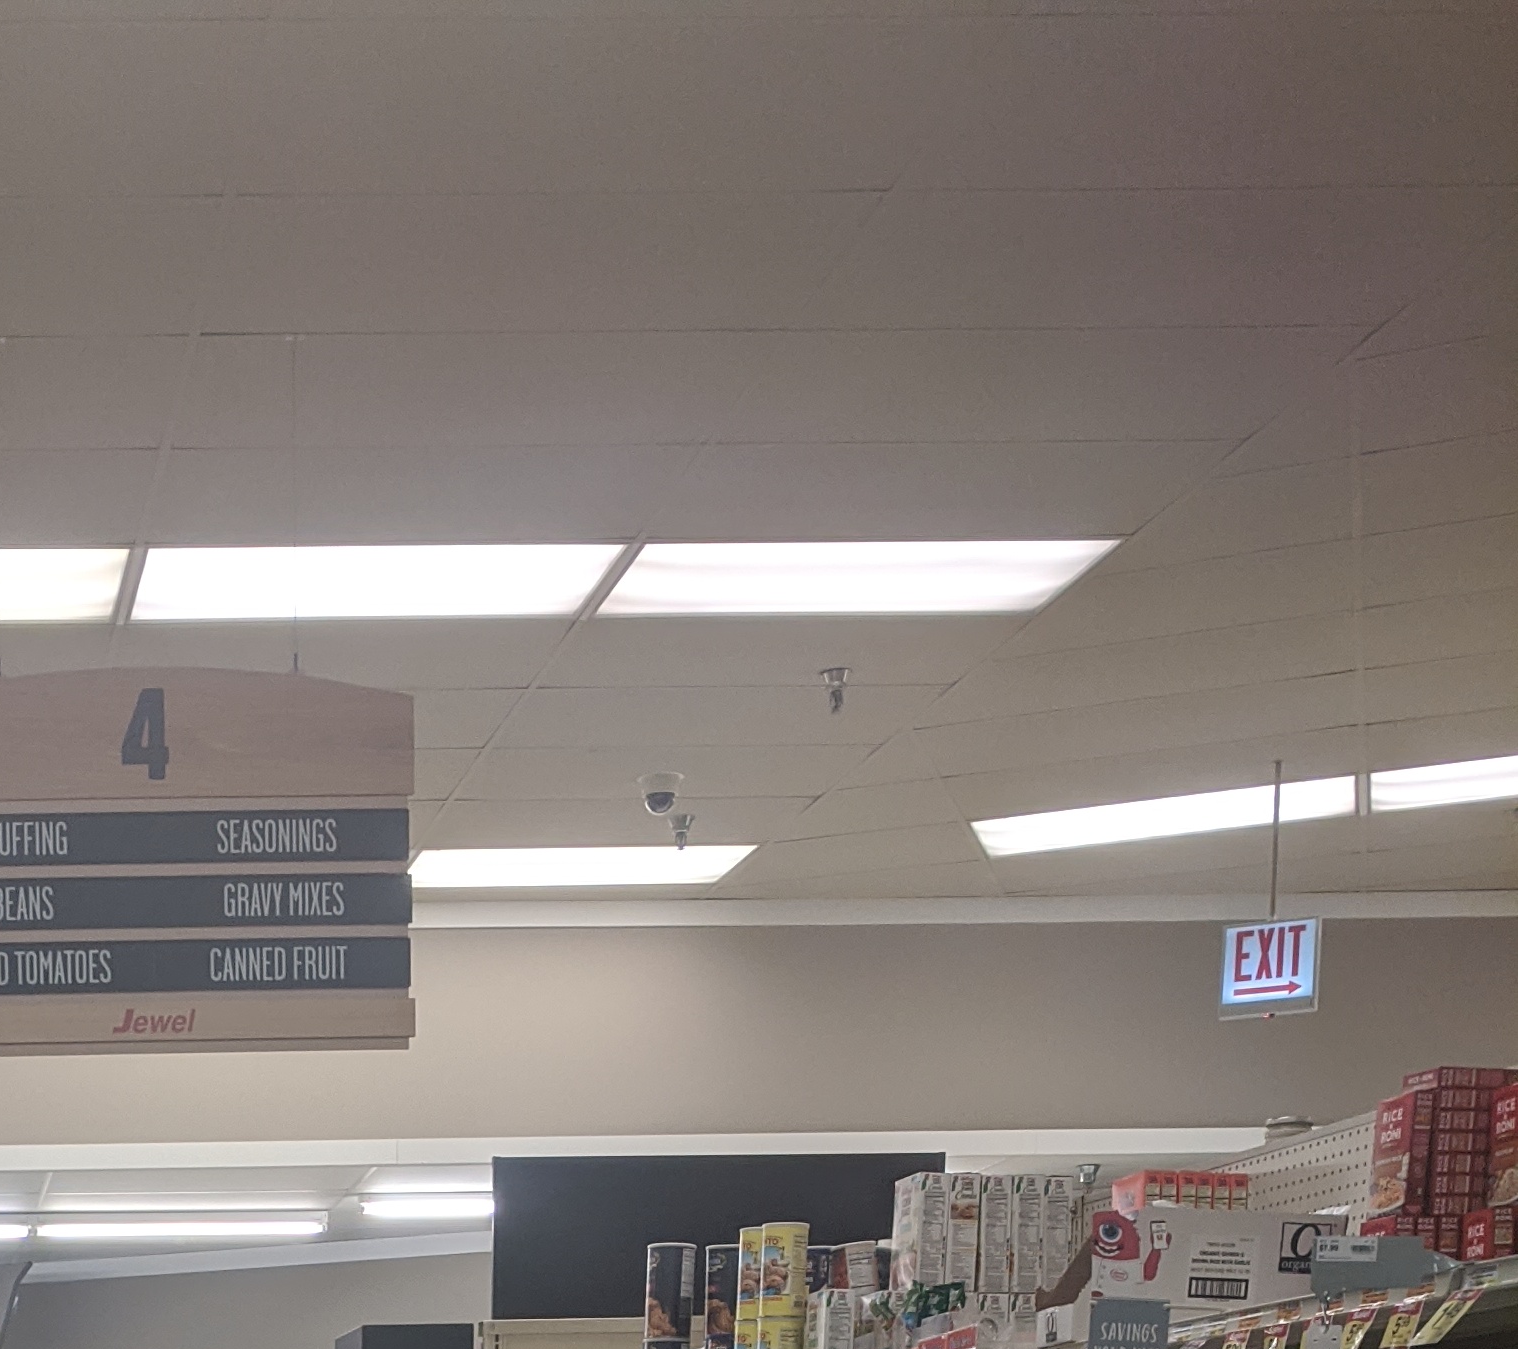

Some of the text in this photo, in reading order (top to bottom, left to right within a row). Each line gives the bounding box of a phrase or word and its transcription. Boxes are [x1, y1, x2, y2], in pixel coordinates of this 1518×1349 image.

[121, 687, 169, 780] 4
[216, 817, 337, 854] SEASONINGS
[223, 882, 344, 917] GRAVY MIXES
[14, 949, 112, 986] TOMATOES
[210, 945, 348, 982] CANNED FRUIT
[1234, 924, 1307, 982] EXIT
[112, 1009, 196, 1035] Jewel
[1383, 1108, 1404, 1123] RICE
[1468, 1224, 1484, 1239] RICE
[1100, 1322, 1158, 1343] SAVINGS
